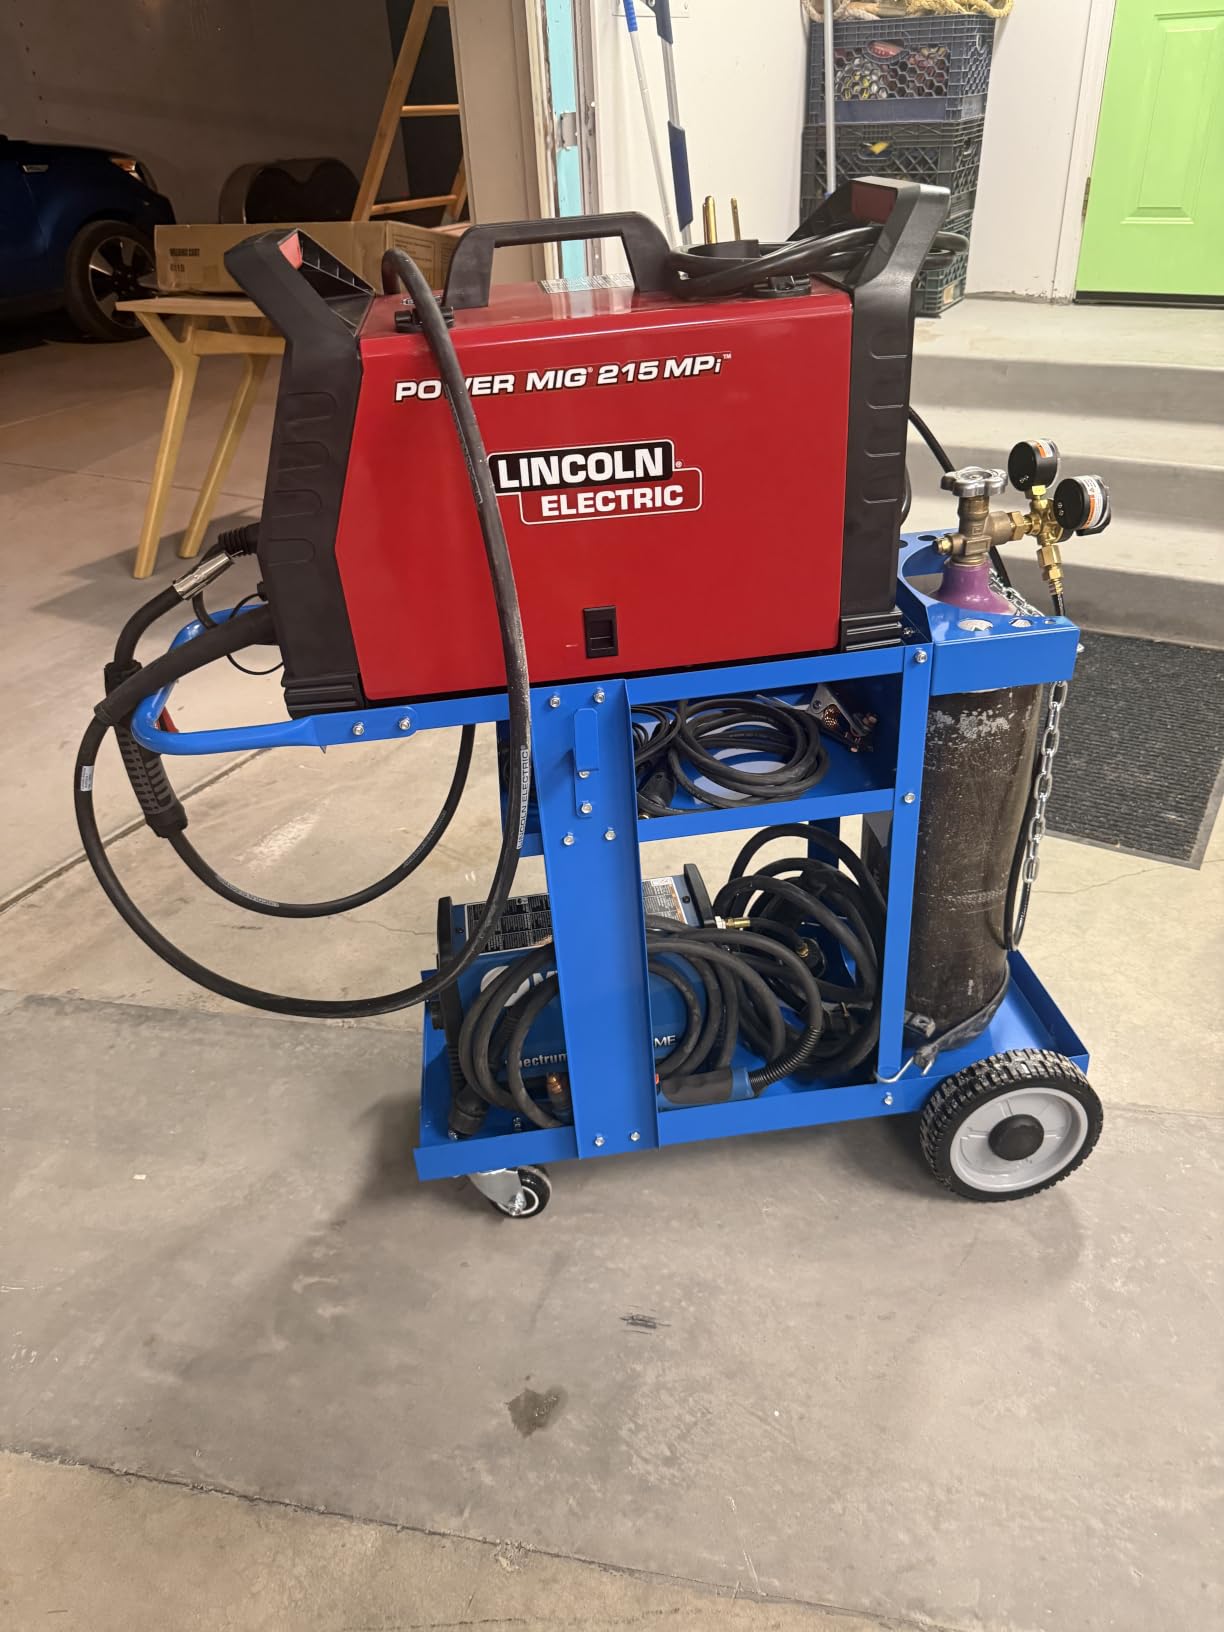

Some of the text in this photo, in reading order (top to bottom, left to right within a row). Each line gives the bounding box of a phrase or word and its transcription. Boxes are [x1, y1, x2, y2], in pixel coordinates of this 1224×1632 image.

[395, 374, 515, 401] POER
[598, 360, 659, 385] 215
[541, 485, 683, 517] ELECTRIC
